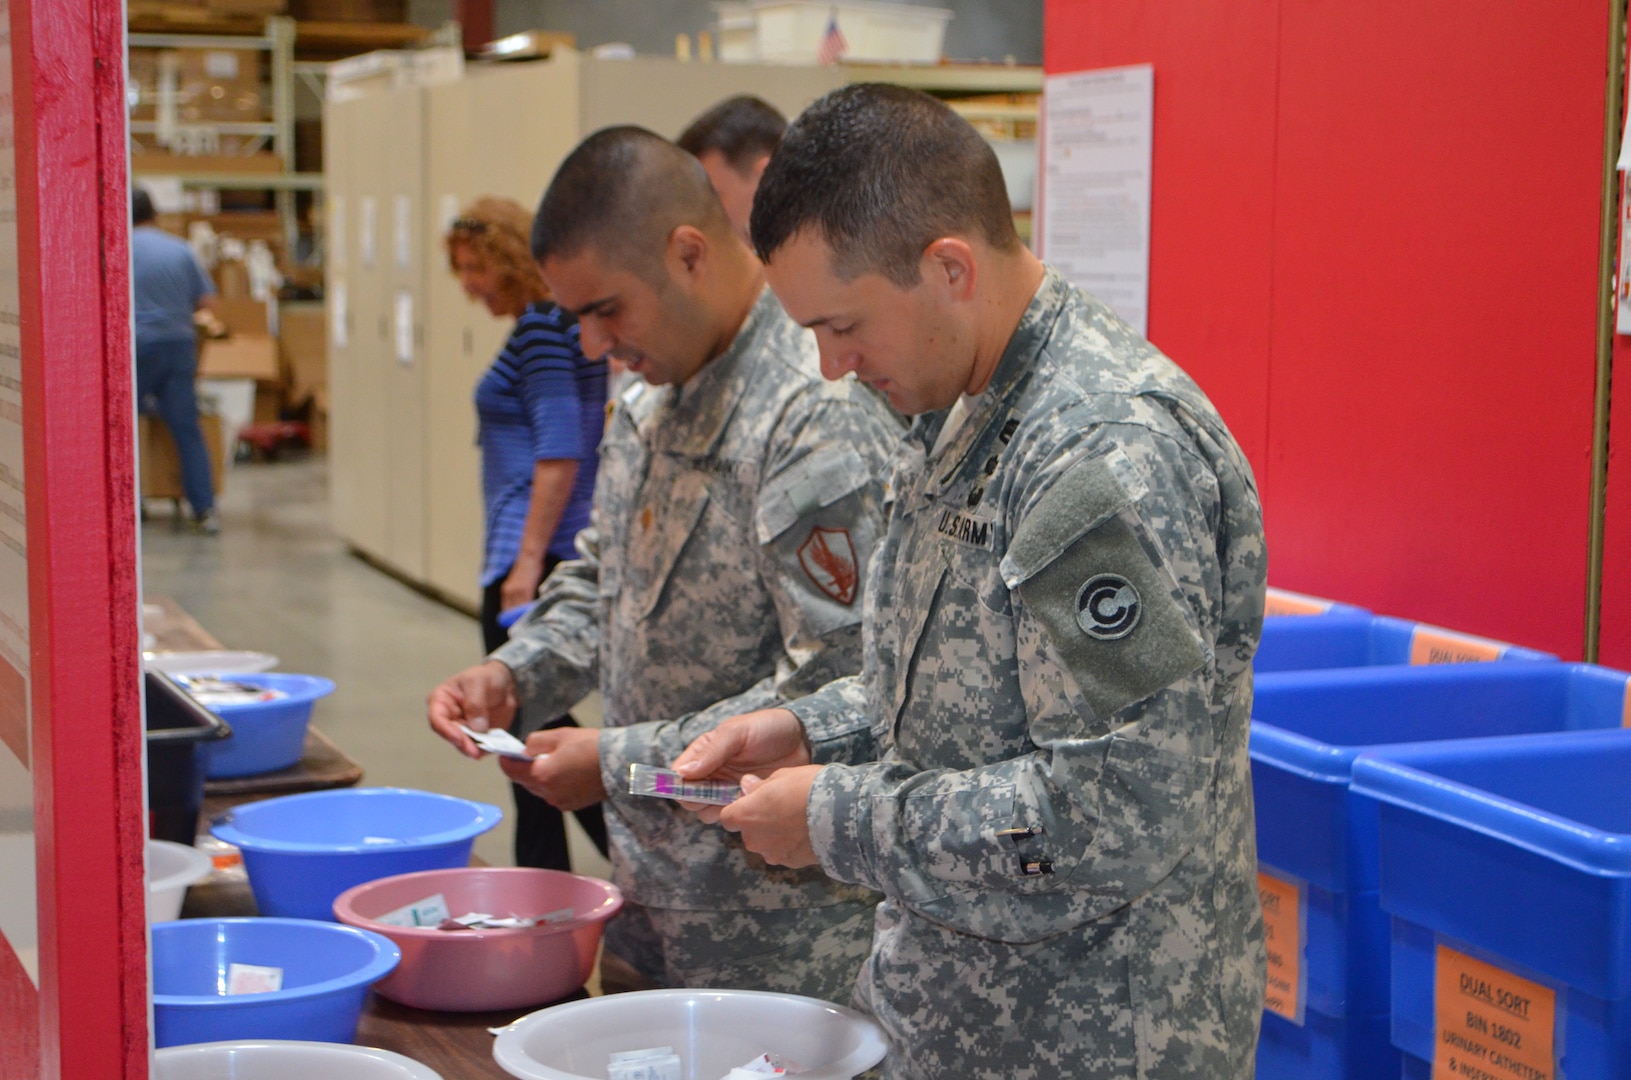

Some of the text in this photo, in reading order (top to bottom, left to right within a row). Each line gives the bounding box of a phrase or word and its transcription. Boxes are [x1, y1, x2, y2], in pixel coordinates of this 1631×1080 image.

[1460, 972, 1531, 1016] DUAL SORT
[1443, 1030, 1488, 1060] URINARY
[1466, 1011, 1522, 1050] BIN 1802
[1449, 1057, 1457, 1071] &
